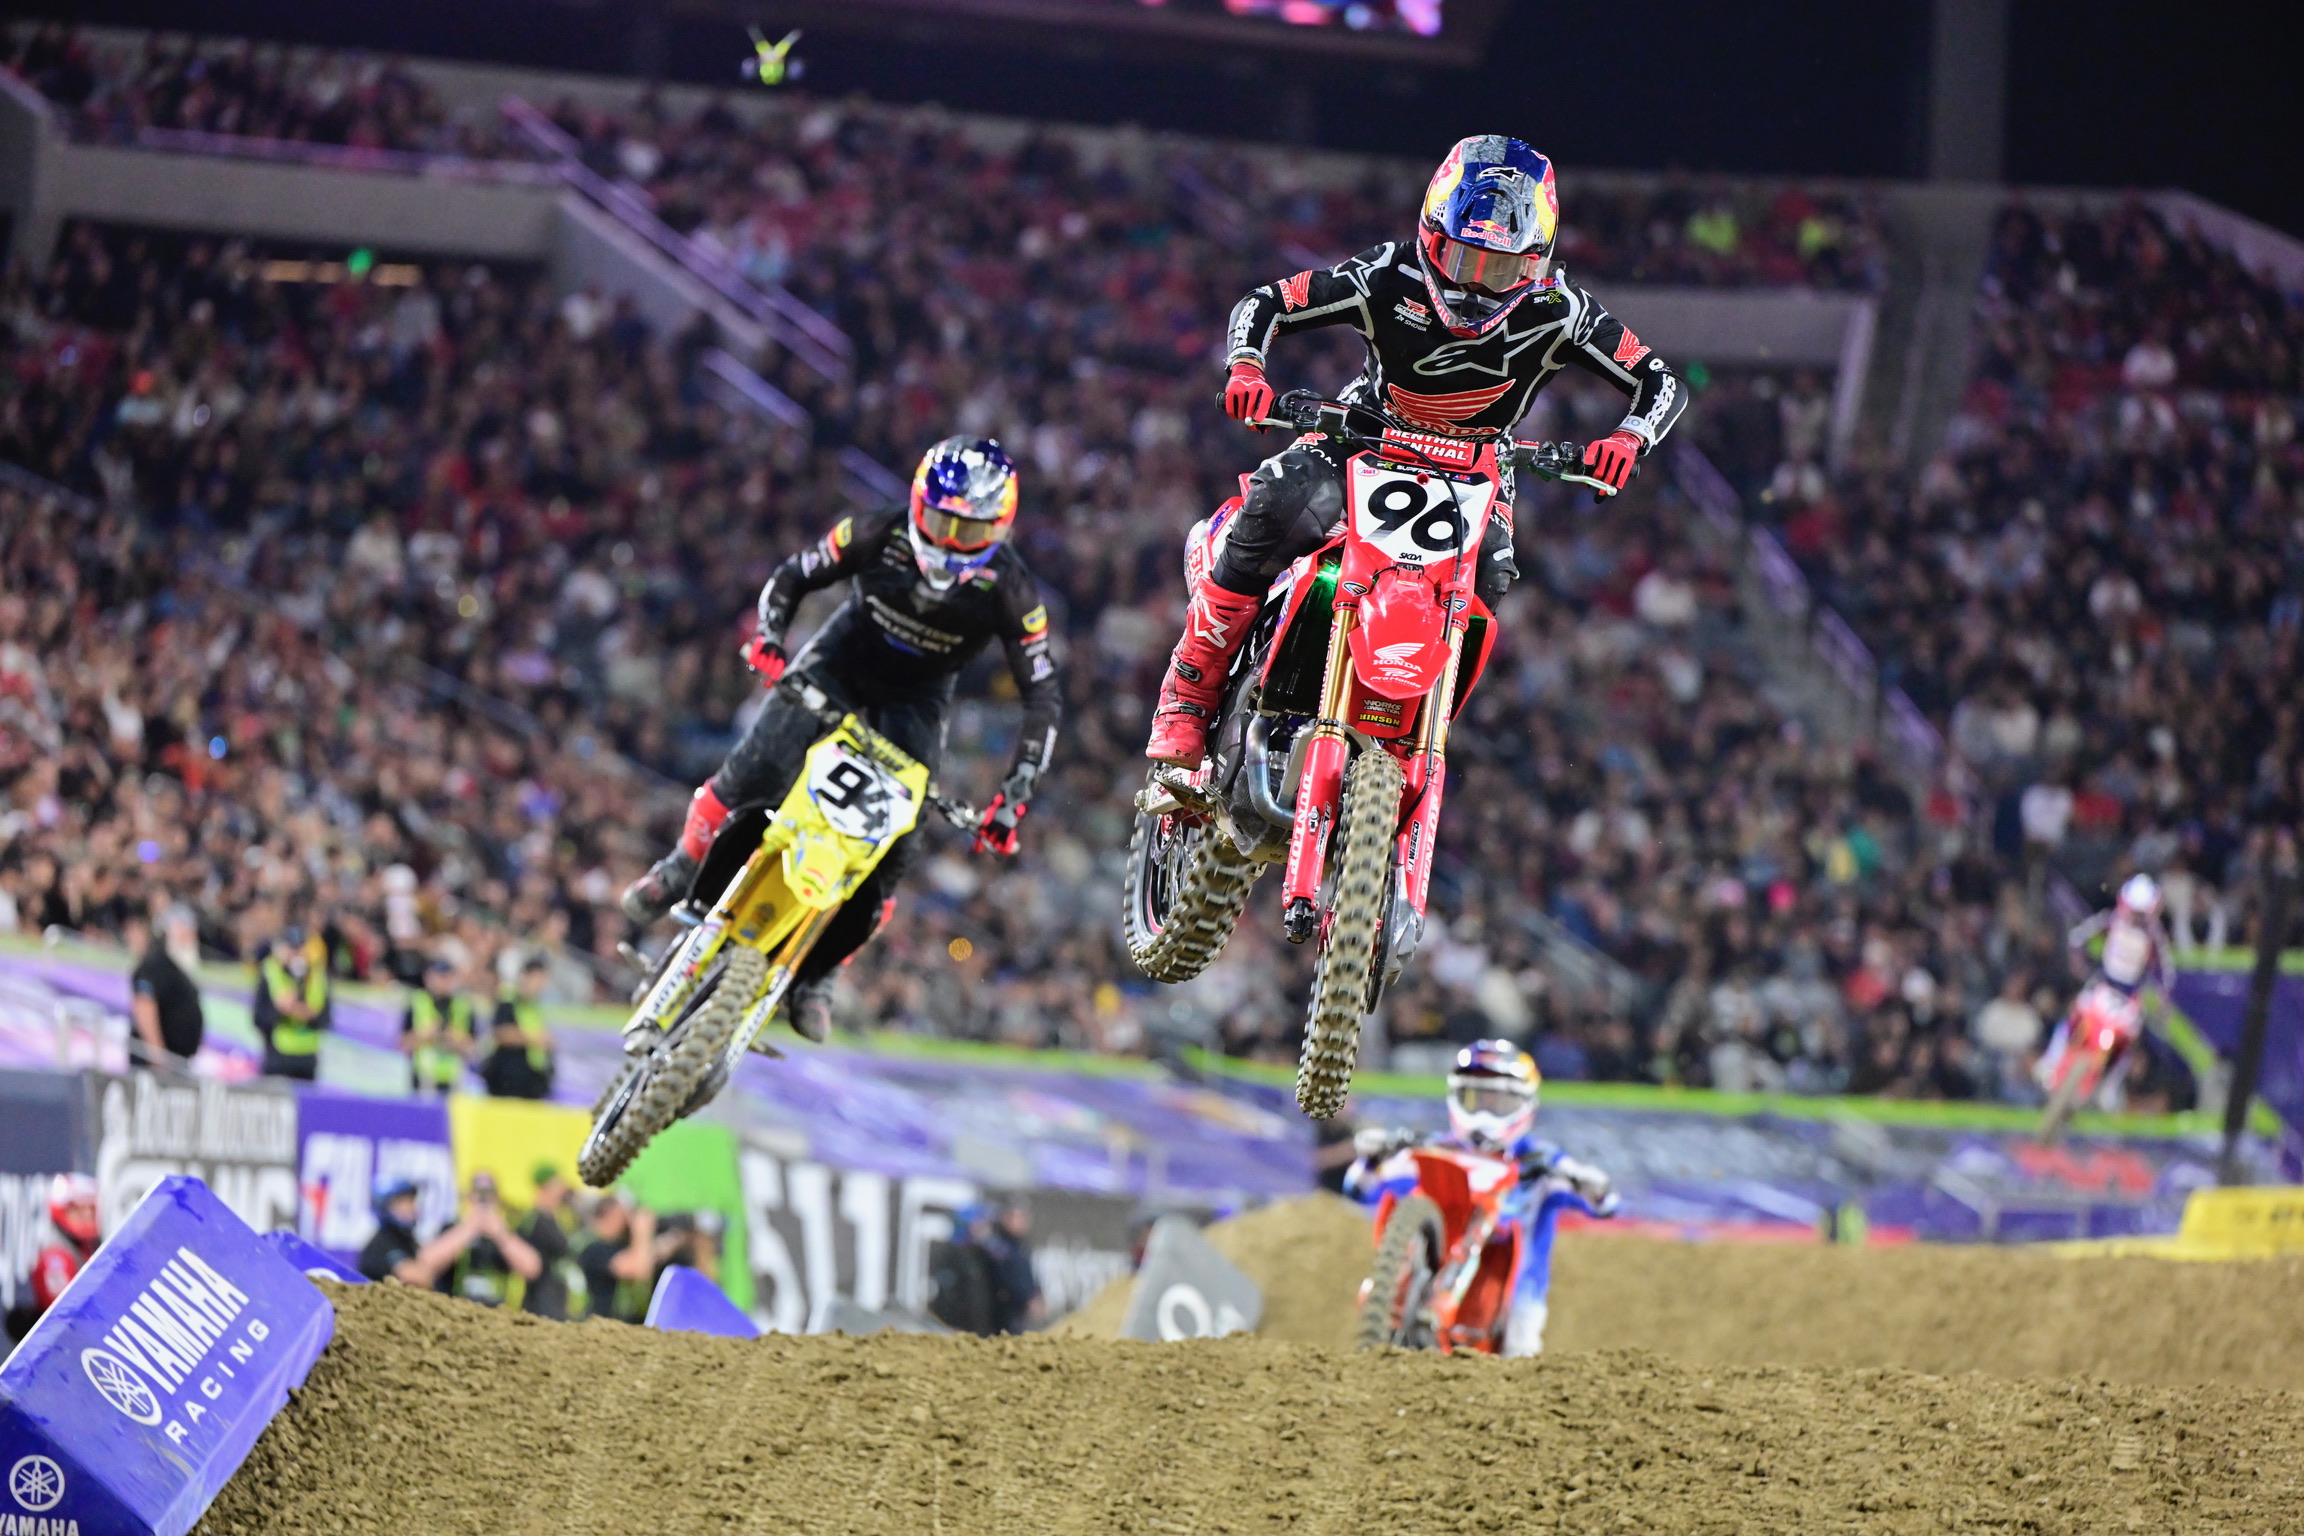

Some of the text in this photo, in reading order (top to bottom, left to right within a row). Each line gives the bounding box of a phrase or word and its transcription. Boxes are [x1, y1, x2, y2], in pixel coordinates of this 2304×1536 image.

[1461, 228, 1512, 247] Red Bull
[1278, 279, 1295, 313] ONDA
[1533, 292, 1563, 305] SMX
[1404, 320, 1427, 332] SHOWA
[1383, 398, 1502, 438] HONDA
[1389, 429, 1471, 449] RENTHAL
[1367, 479, 1471, 552] 96
[1398, 552, 1422, 562] SKDA
[1372, 659, 1424, 673] HONDA
[1363, 699, 1403, 711] WORKS
[1359, 713, 1400, 726] HINSON
[1289, 772, 1313, 875] DUNLOP
[1420, 794, 1440, 902] DUNLOP
[102, 1245, 251, 1396] YAMAHA
[163, 1318, 271, 1445] RACING
